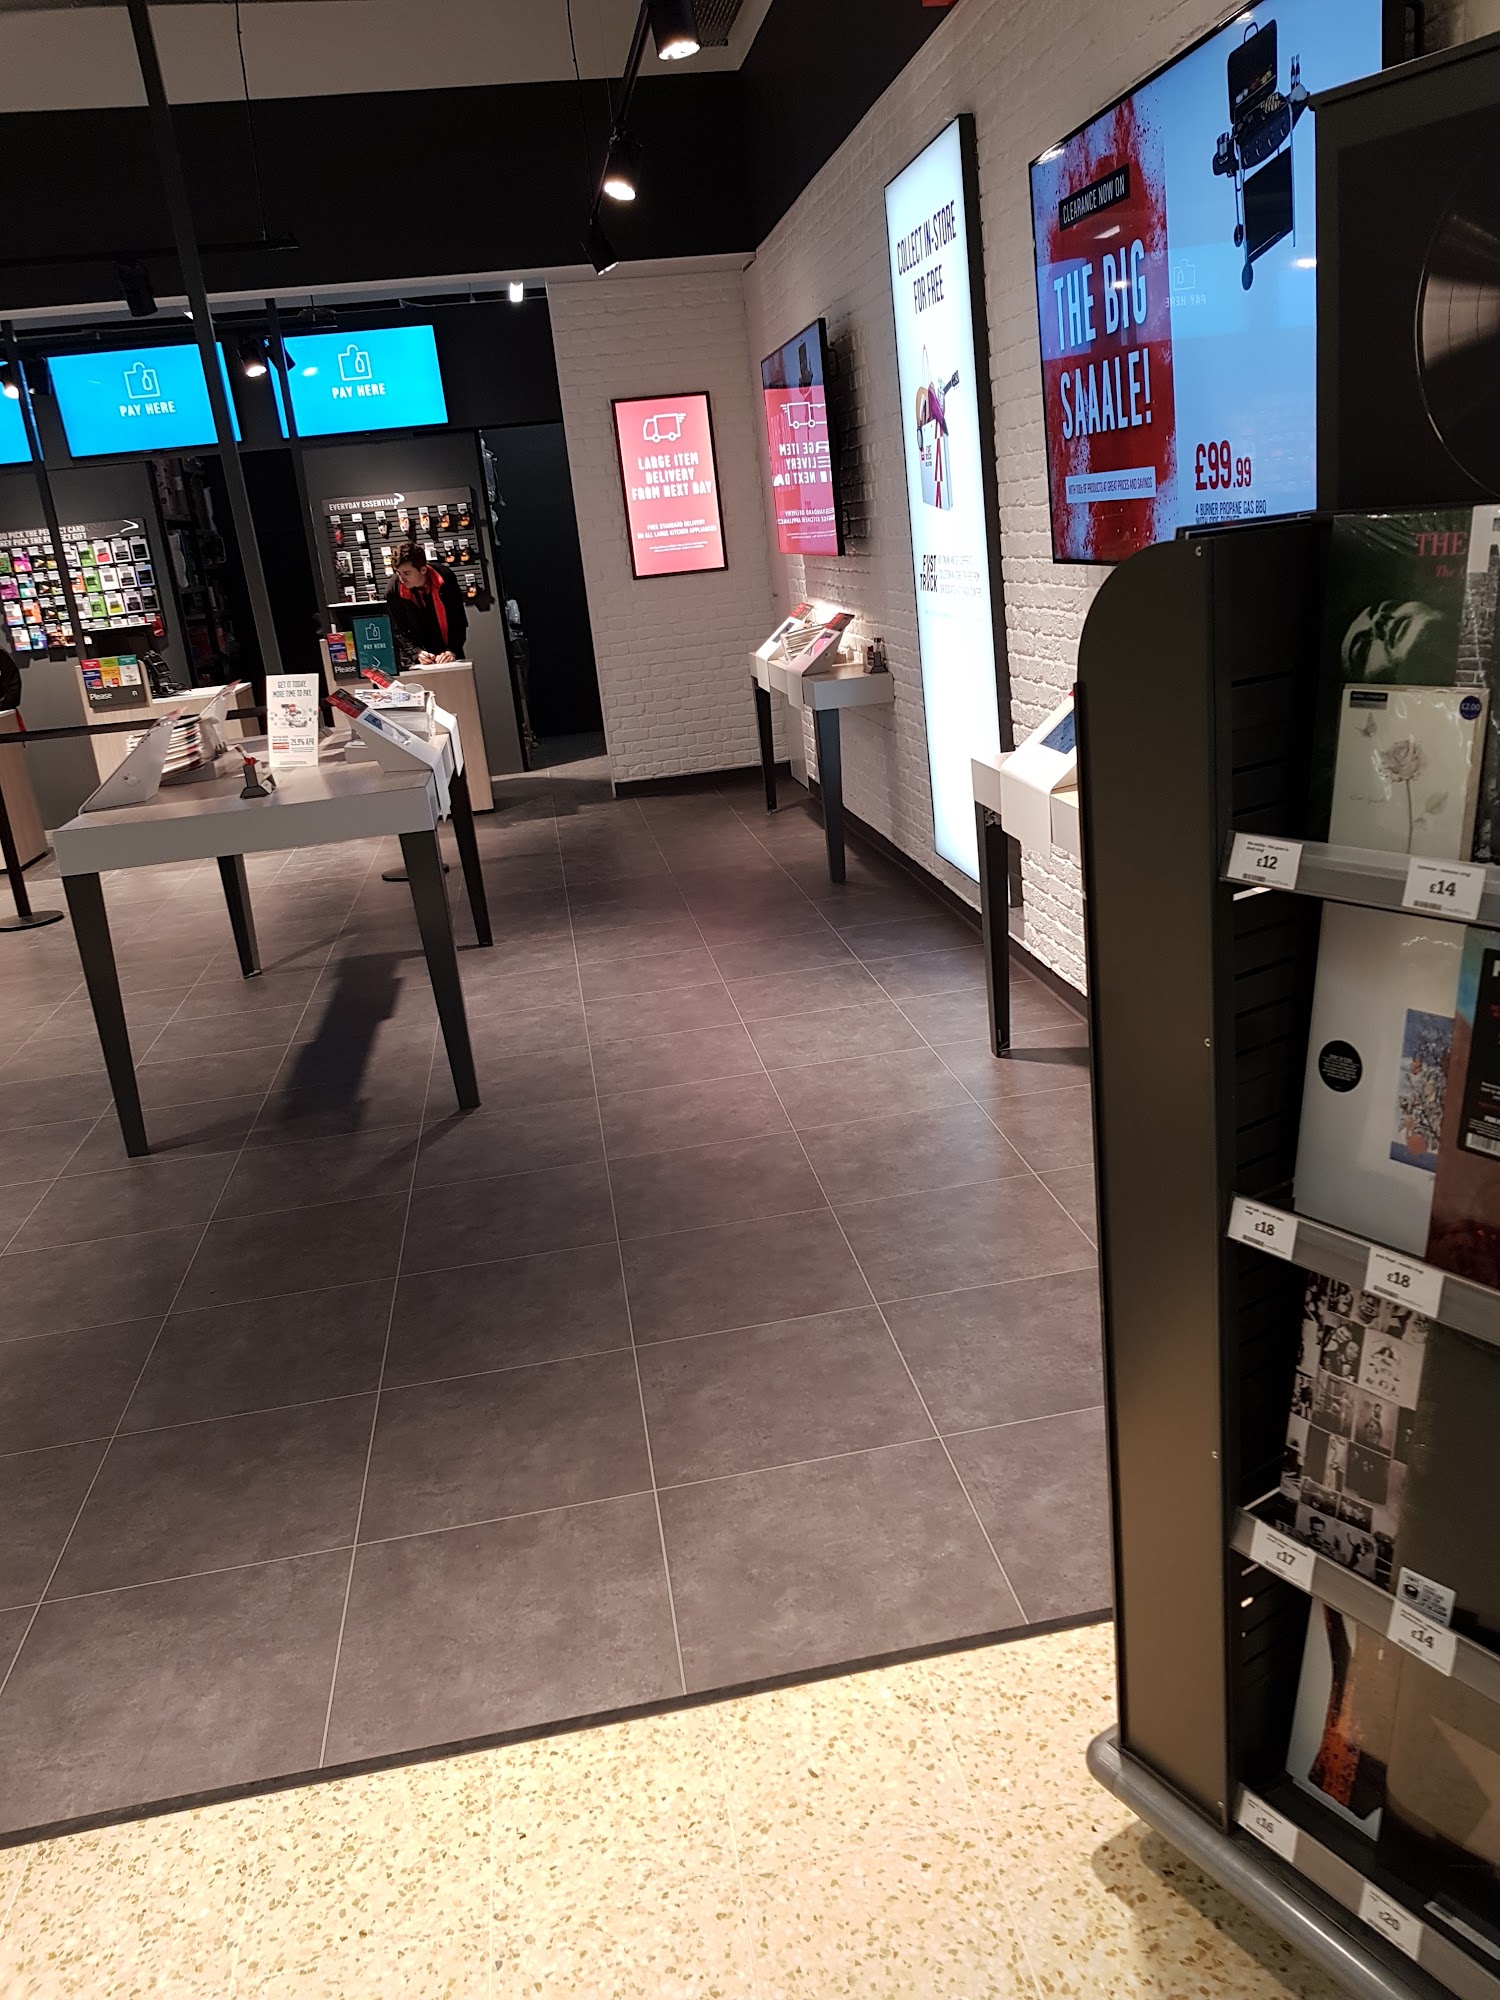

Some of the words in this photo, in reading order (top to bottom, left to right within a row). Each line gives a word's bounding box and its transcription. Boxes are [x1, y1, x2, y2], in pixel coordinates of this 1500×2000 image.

[1062, 189, 1097, 224] CLEARANCE
[1098, 180, 1114, 206] NOW
[1114, 174, 1125, 197] ON
[897, 225, 923, 276] COLLECT
[924, 200, 957, 258] IN-STORE
[913, 276, 927, 315] FOR
[927, 264, 945, 307] FREE
[1053, 262, 1097, 351] THE
[1102, 239, 1147, 335] BIG
[331, 386, 353, 400] PAY
[356, 383, 387, 397] HERE
[1060, 347, 1152, 440] SAAALE!
[119, 404, 141, 418] PAY
[145, 400, 177, 415] HERE
[637, 454, 672, 471] LARGE
[673, 451, 699, 467] ITEM
[1194, 440, 1252, 491] £99.99
[645, 467, 695, 485] DELIVERY
[631, 485, 661, 501] FROM
[663, 482, 689, 498] NEXT
[692, 480, 712, 495] DAY
[328, 502, 360, 511] EVERYDAY
[1195, 503, 1199, 515] 4
[1200, 502, 1219, 516] BURNER
[1220, 501, 1242, 515] PROPANE
[1243, 500, 1255, 513] GAS
[1255, 499, 1267, 514] BBQ
[0, 532, 8, 541] OU
[8, 531, 25, 539] PICK
[24, 529, 39, 538] THE
[67, 525, 86, 534] CARD
[0, 539, 12, 548] HEY
[12, 538, 30, 546] PICK
[29, 536, 43, 545] THE
[71, 532, 87, 541] GIFT
[1415, 531, 1468, 556] THE
[922, 554, 937, 573] FAST
[920, 573, 938, 593] TRACK
[272, 690, 285, 698] MORE
[286, 690, 296, 698] TIME
[297, 689, 303, 697] TO
[1461, 702, 1480, 712] £2.00
[305, 737, 315, 746] APR
[1256, 855, 1278, 870] £12
[1429, 880, 1456, 896] £14
[1254, 1222, 1275, 1236] £18
[1387, 1272, 1411, 1288] £18
[1276, 1551, 1296, 1566] £17
[1411, 1630, 1434, 1649] £14
[1256, 1817, 1274, 1834] £16
